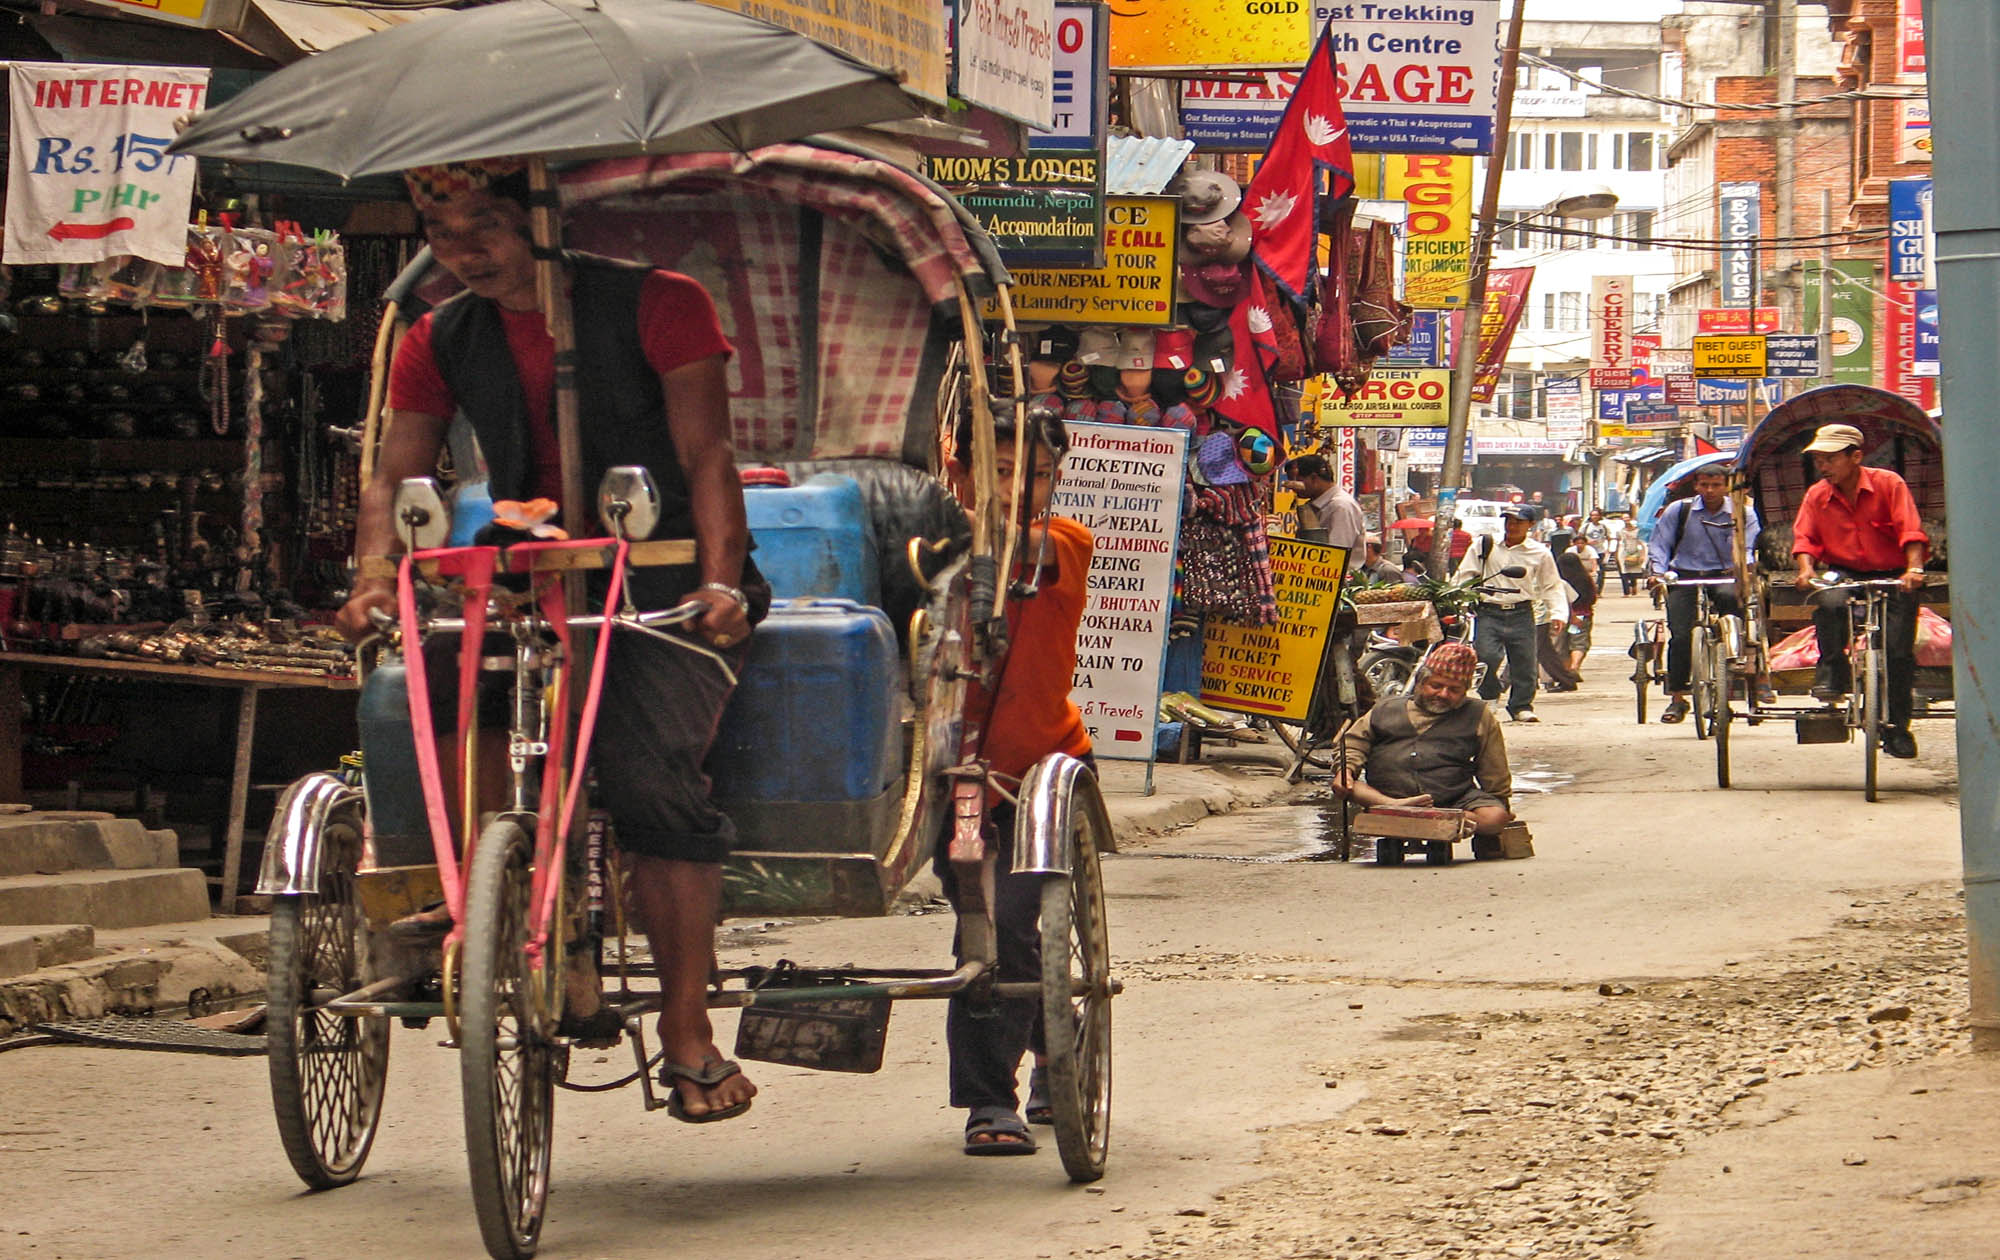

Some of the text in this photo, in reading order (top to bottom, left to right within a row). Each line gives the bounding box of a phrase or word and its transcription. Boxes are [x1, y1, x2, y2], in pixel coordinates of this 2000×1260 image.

[1246, 1, 1299, 15] GOLD
[1316, 4, 1474, 26] est Trekking
[1368, 32, 1462, 55] Centre
[33, 78, 206, 110] INTERNET
[1185, 113, 1200, 122] Our
[1202, 113, 1237, 123] Service
[1388, 118, 1408, 127] Thai
[1417, 119, 1473, 129] Acupressure
[1192, 129, 1446, 145] Relaxing Steam Yoga USA Training
[30, 136, 101, 175] Rs.
[932, 156, 1097, 183] MOM'S LODGE
[987, 212, 1094, 237] Accomodation
[1121, 229, 1166, 248] CALL
[1114, 253, 1157, 270] TOUR
[1432, 258, 1467, 272] IMPORT
[1117, 275, 1162, 290] TOUR
[1021, 295, 1088, 314] Laundry
[1092, 295, 1155, 312] Service
[1603, 293, 1624, 368] CHERRY
[1696, 341, 1725, 351] TIBET
[1728, 340, 1763, 351] GUEST
[1707, 353, 1752, 364] HOUSE
[1593, 377, 1632, 386] House
[1594, 368, 1632, 377] Guest
[1323, 402, 1338, 411] SEA
[1339, 401, 1364, 411] CRGO
[1411, 402, 1442, 411] COURIER
[1071, 431, 1175, 455] Information
[1069, 456, 1166, 478] TICKETING
[1102, 495, 1163, 513] FLIGHT
[1108, 516, 1163, 534] NEPAL
[1091, 555, 1141, 572] EEING
[1311, 564, 1341, 580] CALL
[1087, 575, 1145, 592] SAFARI
[1289, 574, 1303, 587] TO
[1306, 577, 1334, 594] INDIA
[1276, 589, 1322, 608] CABLE
[1272, 620, 1319, 640] TICKET
[1078, 634, 1114, 649] WAN
[1242, 633, 1280, 650] INDIA
[1075, 653, 1144, 672] RAIN TO
[1217, 645, 1281, 667] TICKET
[1230, 664, 1293, 686] SERVICE
[1234, 682, 1294, 703] SERVICE
[1084, 700, 1095, 715] &
[1098, 701, 1144, 720] Travels
